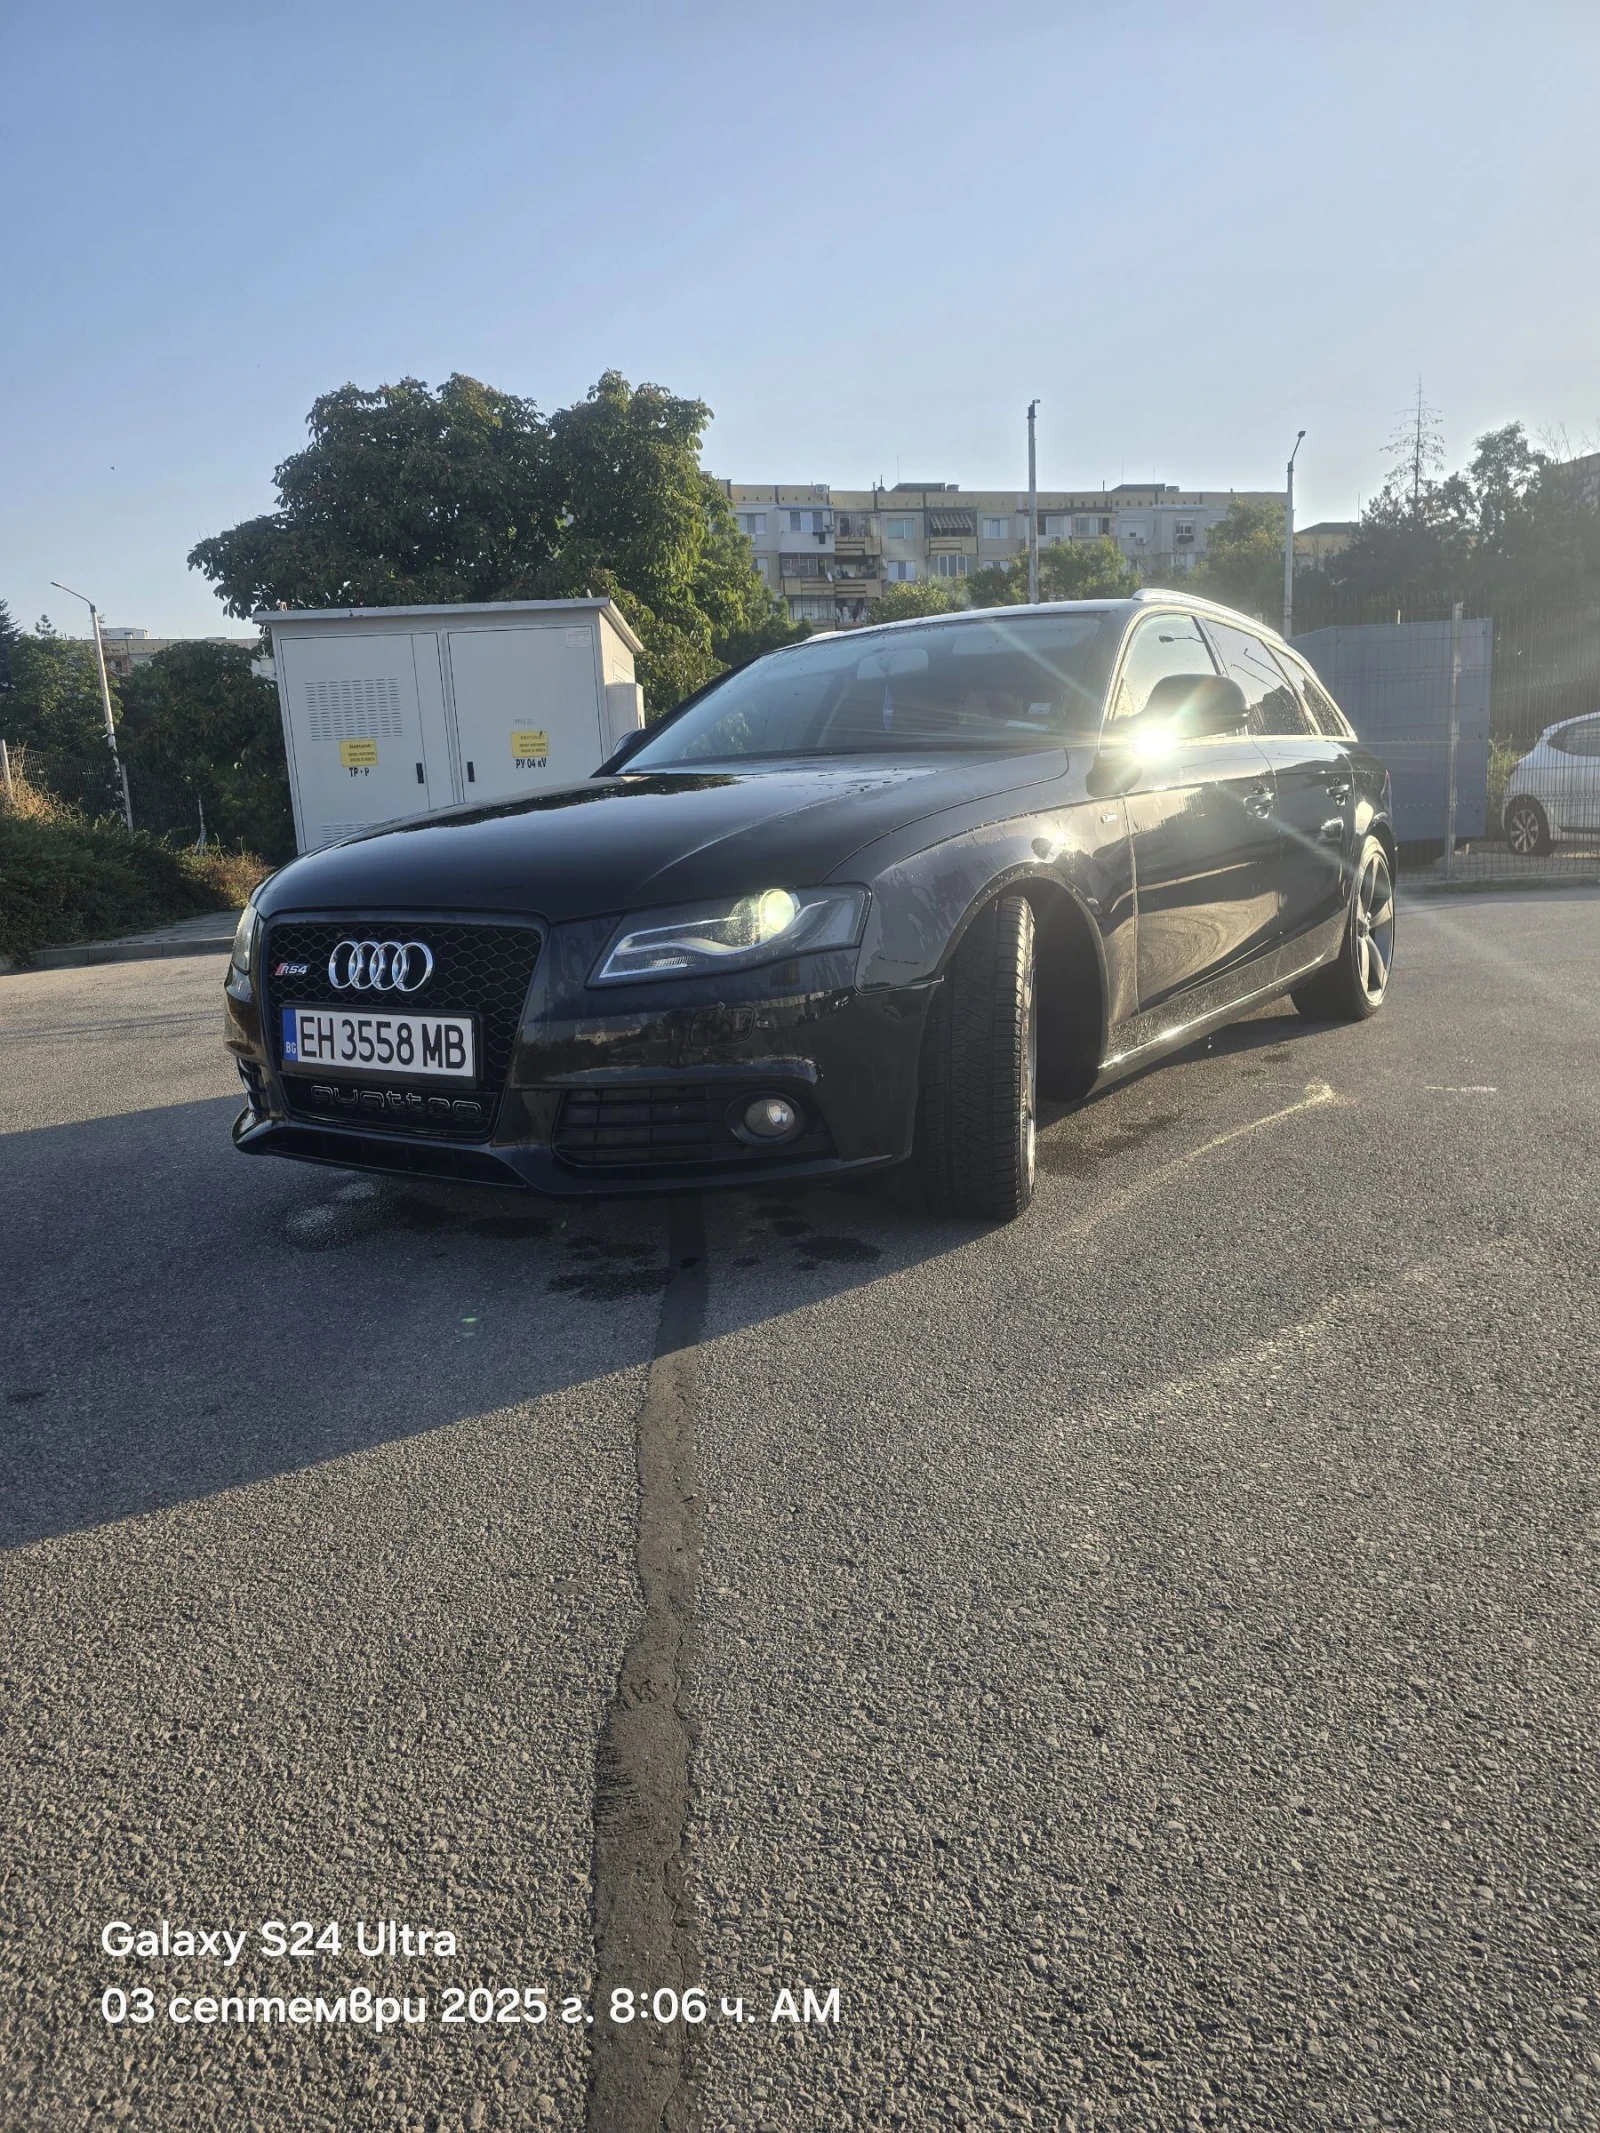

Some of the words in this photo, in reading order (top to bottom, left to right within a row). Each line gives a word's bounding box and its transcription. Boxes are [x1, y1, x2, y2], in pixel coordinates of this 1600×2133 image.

[279, 964, 309, 976] RS4
[285, 1041, 297, 1054] BG
[341, 1019, 415, 1066] 3558
[310, 1085, 482, 1118] quattro
